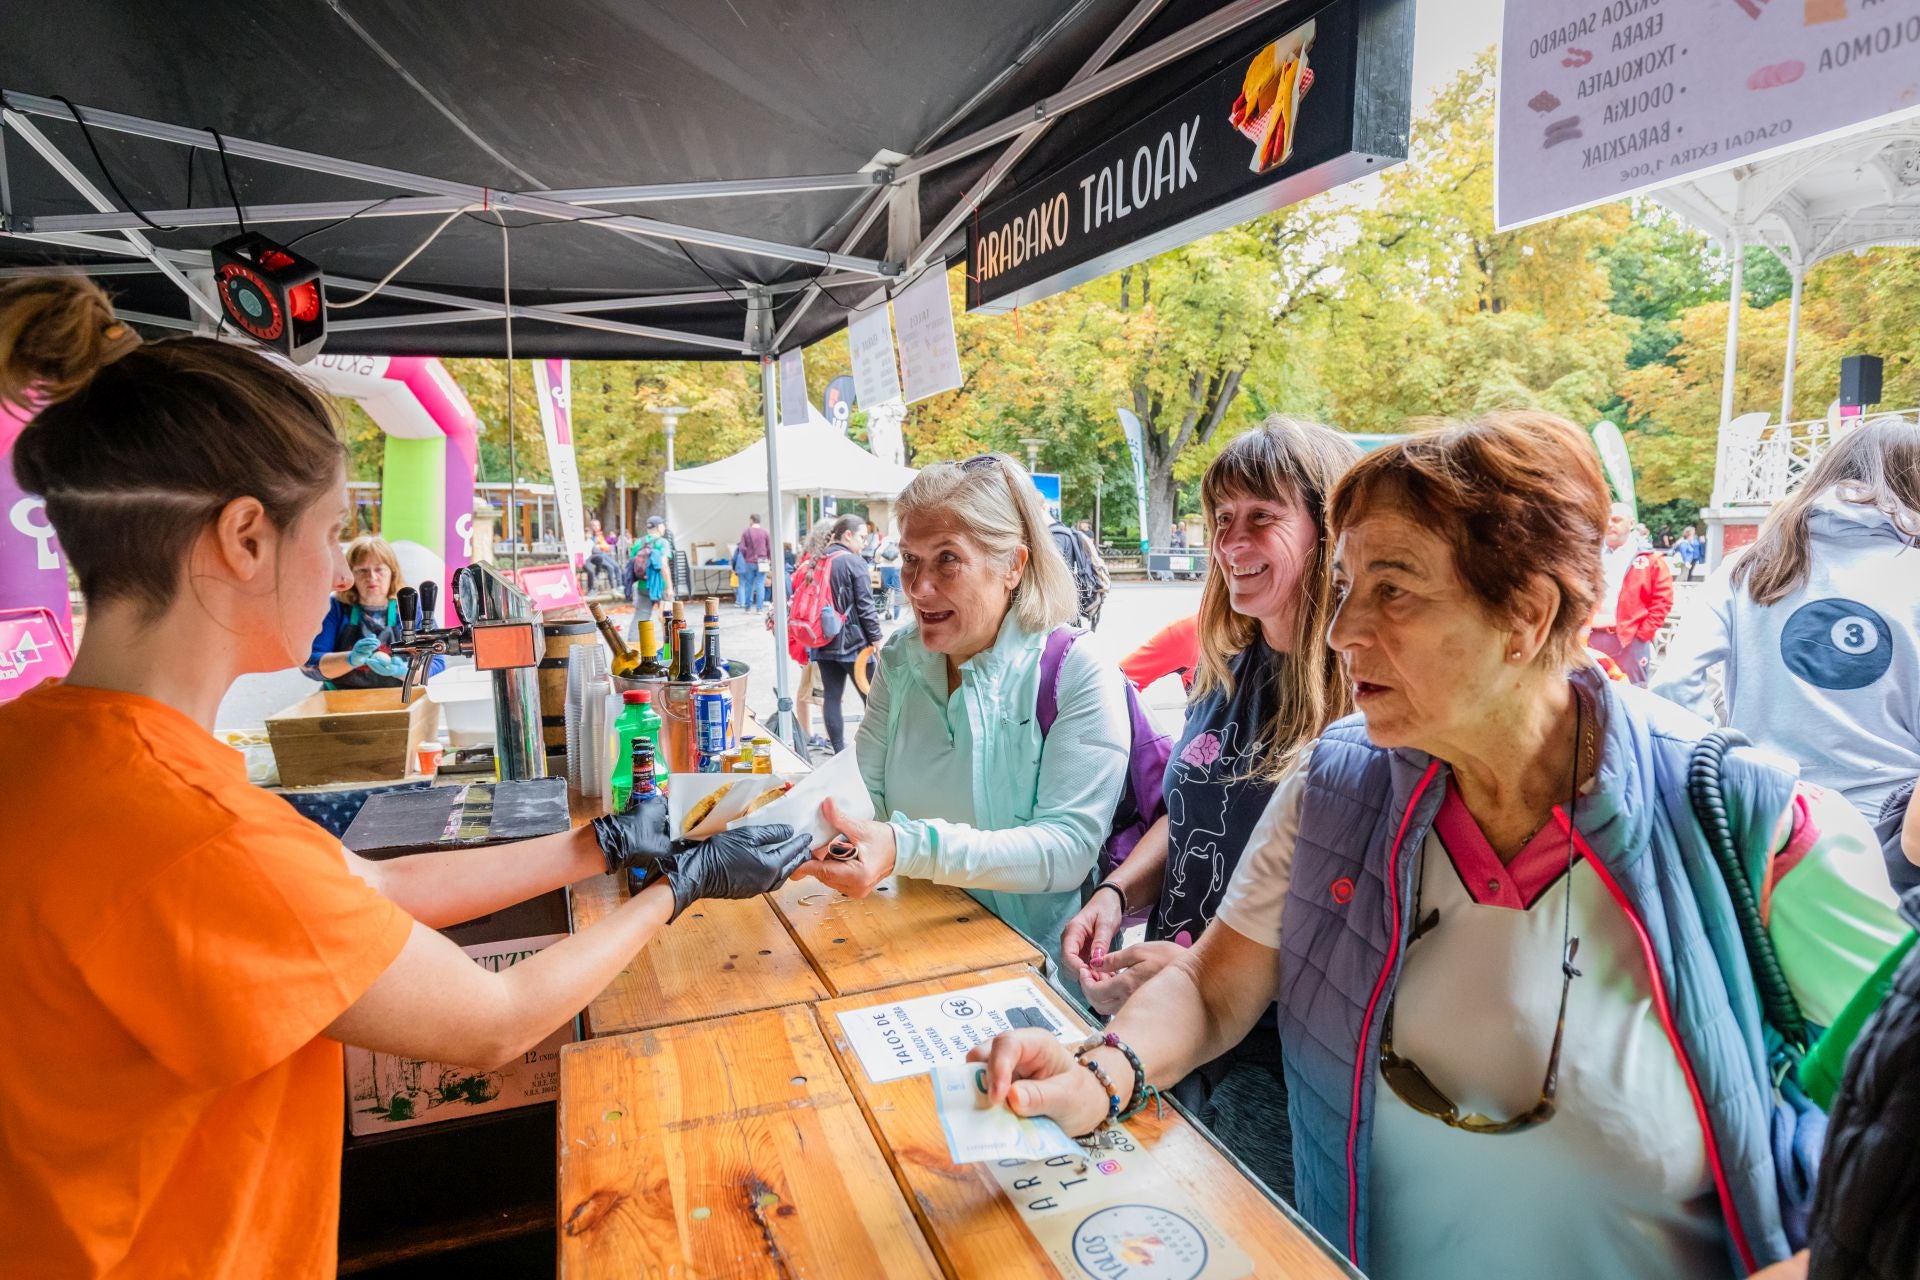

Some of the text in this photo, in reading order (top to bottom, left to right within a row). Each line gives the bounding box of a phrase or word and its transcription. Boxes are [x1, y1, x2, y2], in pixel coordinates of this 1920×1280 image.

[977, 114, 1201, 282] ARABAKO TALOAK
[1843, 622, 1865, 648] 3
[949, 1000, 974, 1016] 6€
[872, 1012, 913, 1065] TALOS DE
[524, 1050, 537, 1065] 12
